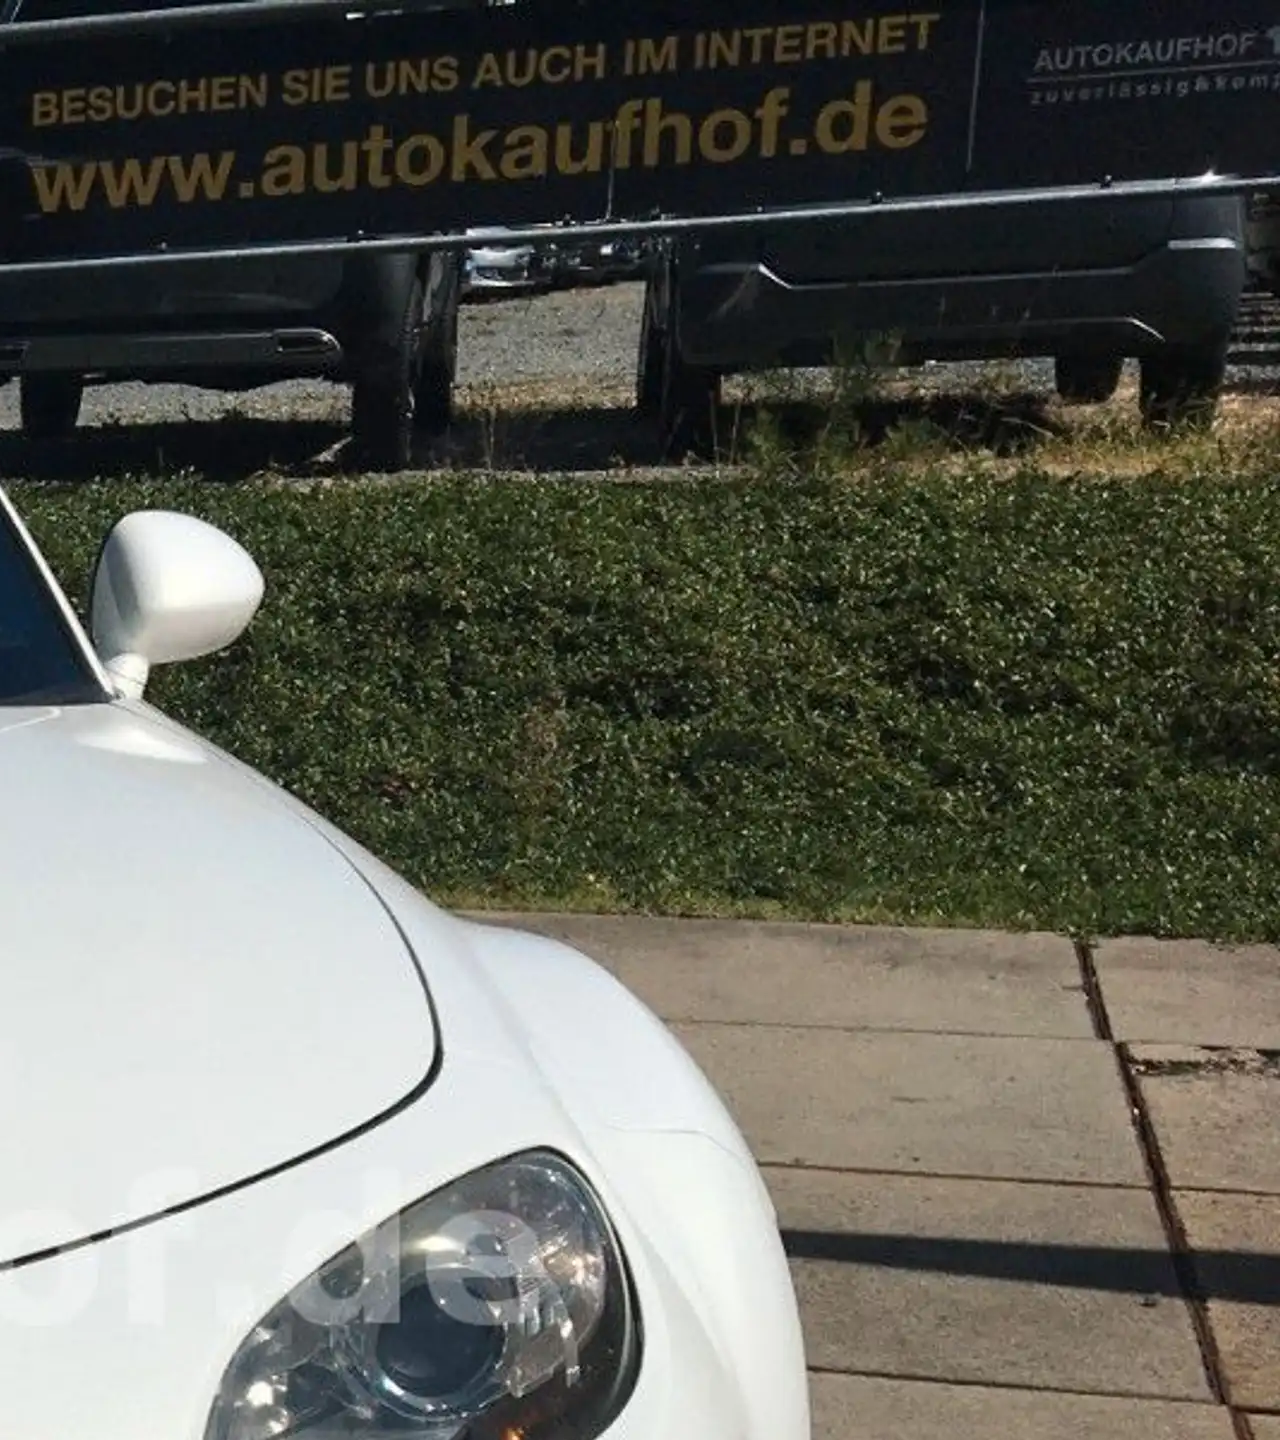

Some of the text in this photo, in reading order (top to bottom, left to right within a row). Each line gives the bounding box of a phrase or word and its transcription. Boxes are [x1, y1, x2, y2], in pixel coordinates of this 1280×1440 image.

[31, 14, 941, 126] BESUCHEN SIE UNS AUCH IM INTERNET
[1033, 31, 1258, 72] AUTOKAUFHOF
[32, 79, 930, 213] www.autokaufhof.de
